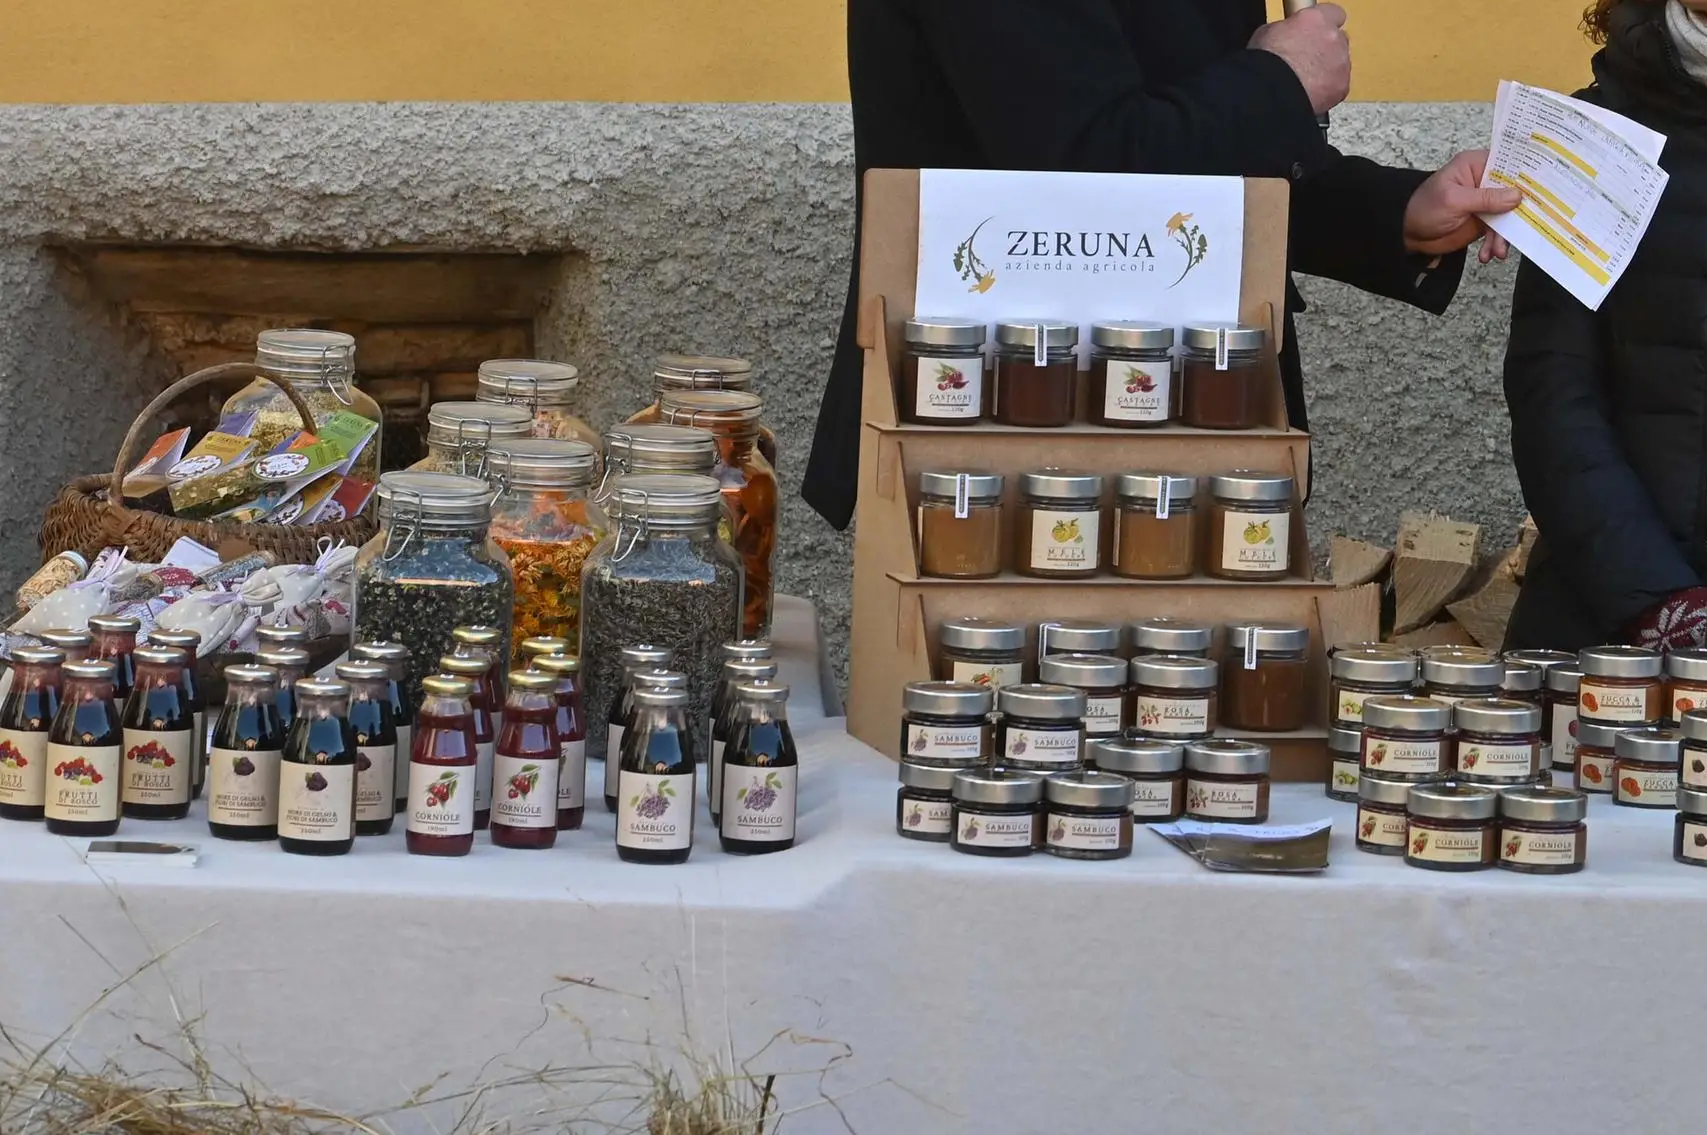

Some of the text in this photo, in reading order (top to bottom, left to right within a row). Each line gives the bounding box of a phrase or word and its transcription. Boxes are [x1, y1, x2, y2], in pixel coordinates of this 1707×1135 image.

[1007, 230, 1155, 258] ZERUNA
[1006, 260, 1156, 275] azienda agricola
[929, 394, 972, 403] CASTAGNE
[1117, 396, 1160, 405] CASTAGNE
[0, 774, 23, 782] UTTI
[498, 802, 541, 813] CORNIOLE
[415, 812, 460, 821] CORNIOLE
[737, 815, 782, 824] SAMBUCO
[630, 823, 676, 832] SAMBUCO
[985, 823, 1029, 831] SAMBUCO
[1071, 825, 1116, 833] SAMBUCO
